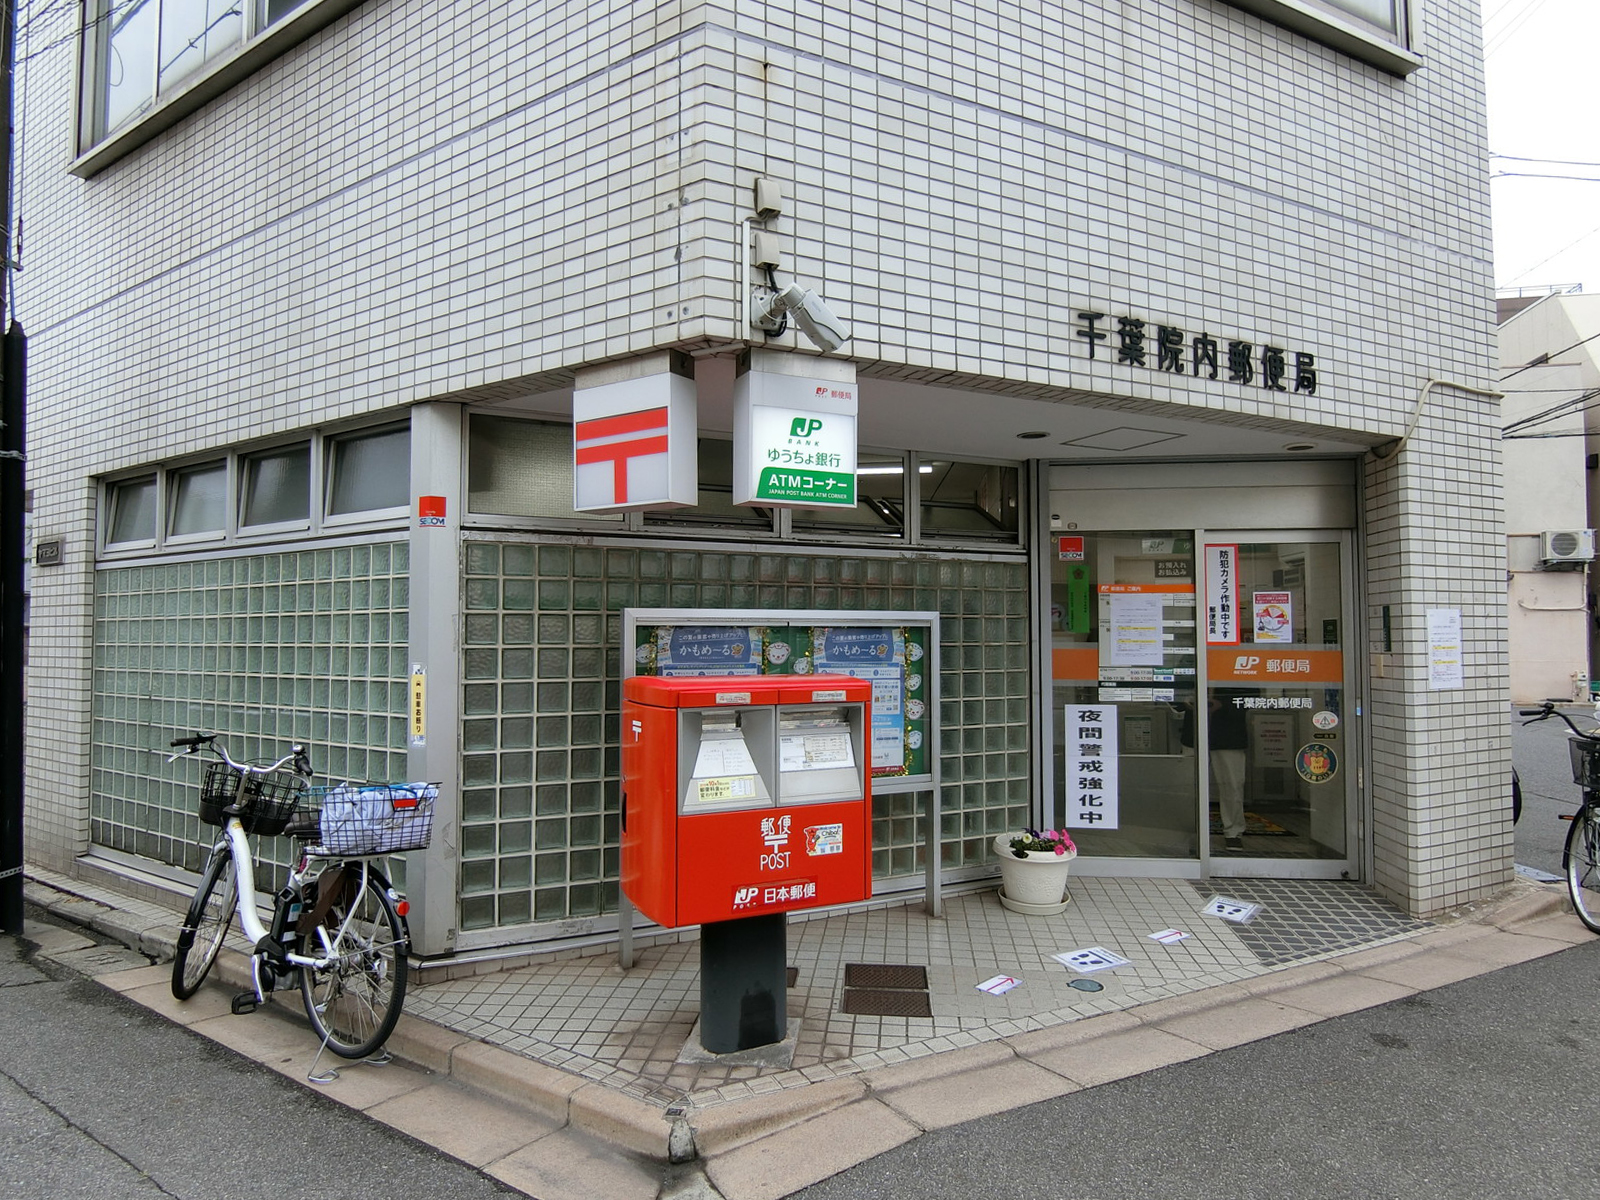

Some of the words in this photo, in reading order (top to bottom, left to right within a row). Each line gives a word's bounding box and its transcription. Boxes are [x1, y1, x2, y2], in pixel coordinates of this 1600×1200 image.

[1077, 312, 1316, 394] 千葉院内郵便局
[831, 390, 852, 401] 郵便局
[790, 417, 822, 437] JP
[788, 438, 820, 447] BANK
[768, 448, 841, 467] ゆうちょ銀行
[768, 474, 848, 490] ATMコーナー
[419, 517, 445, 525] SECOM
[1219, 550, 1230, 639] 防犯カメラ作動中です
[1209, 606, 1217, 634] 郵便局長
[1266, 659, 1311, 673] 郵便局
[1232, 697, 1312, 709] 千葉院内郵便局
[1078, 710, 1103, 824] 夜間警戒強化中
[760, 815, 791, 837] 郵便
[760, 852, 791, 871] POST
[764, 882, 816, 904] 日本郵便
